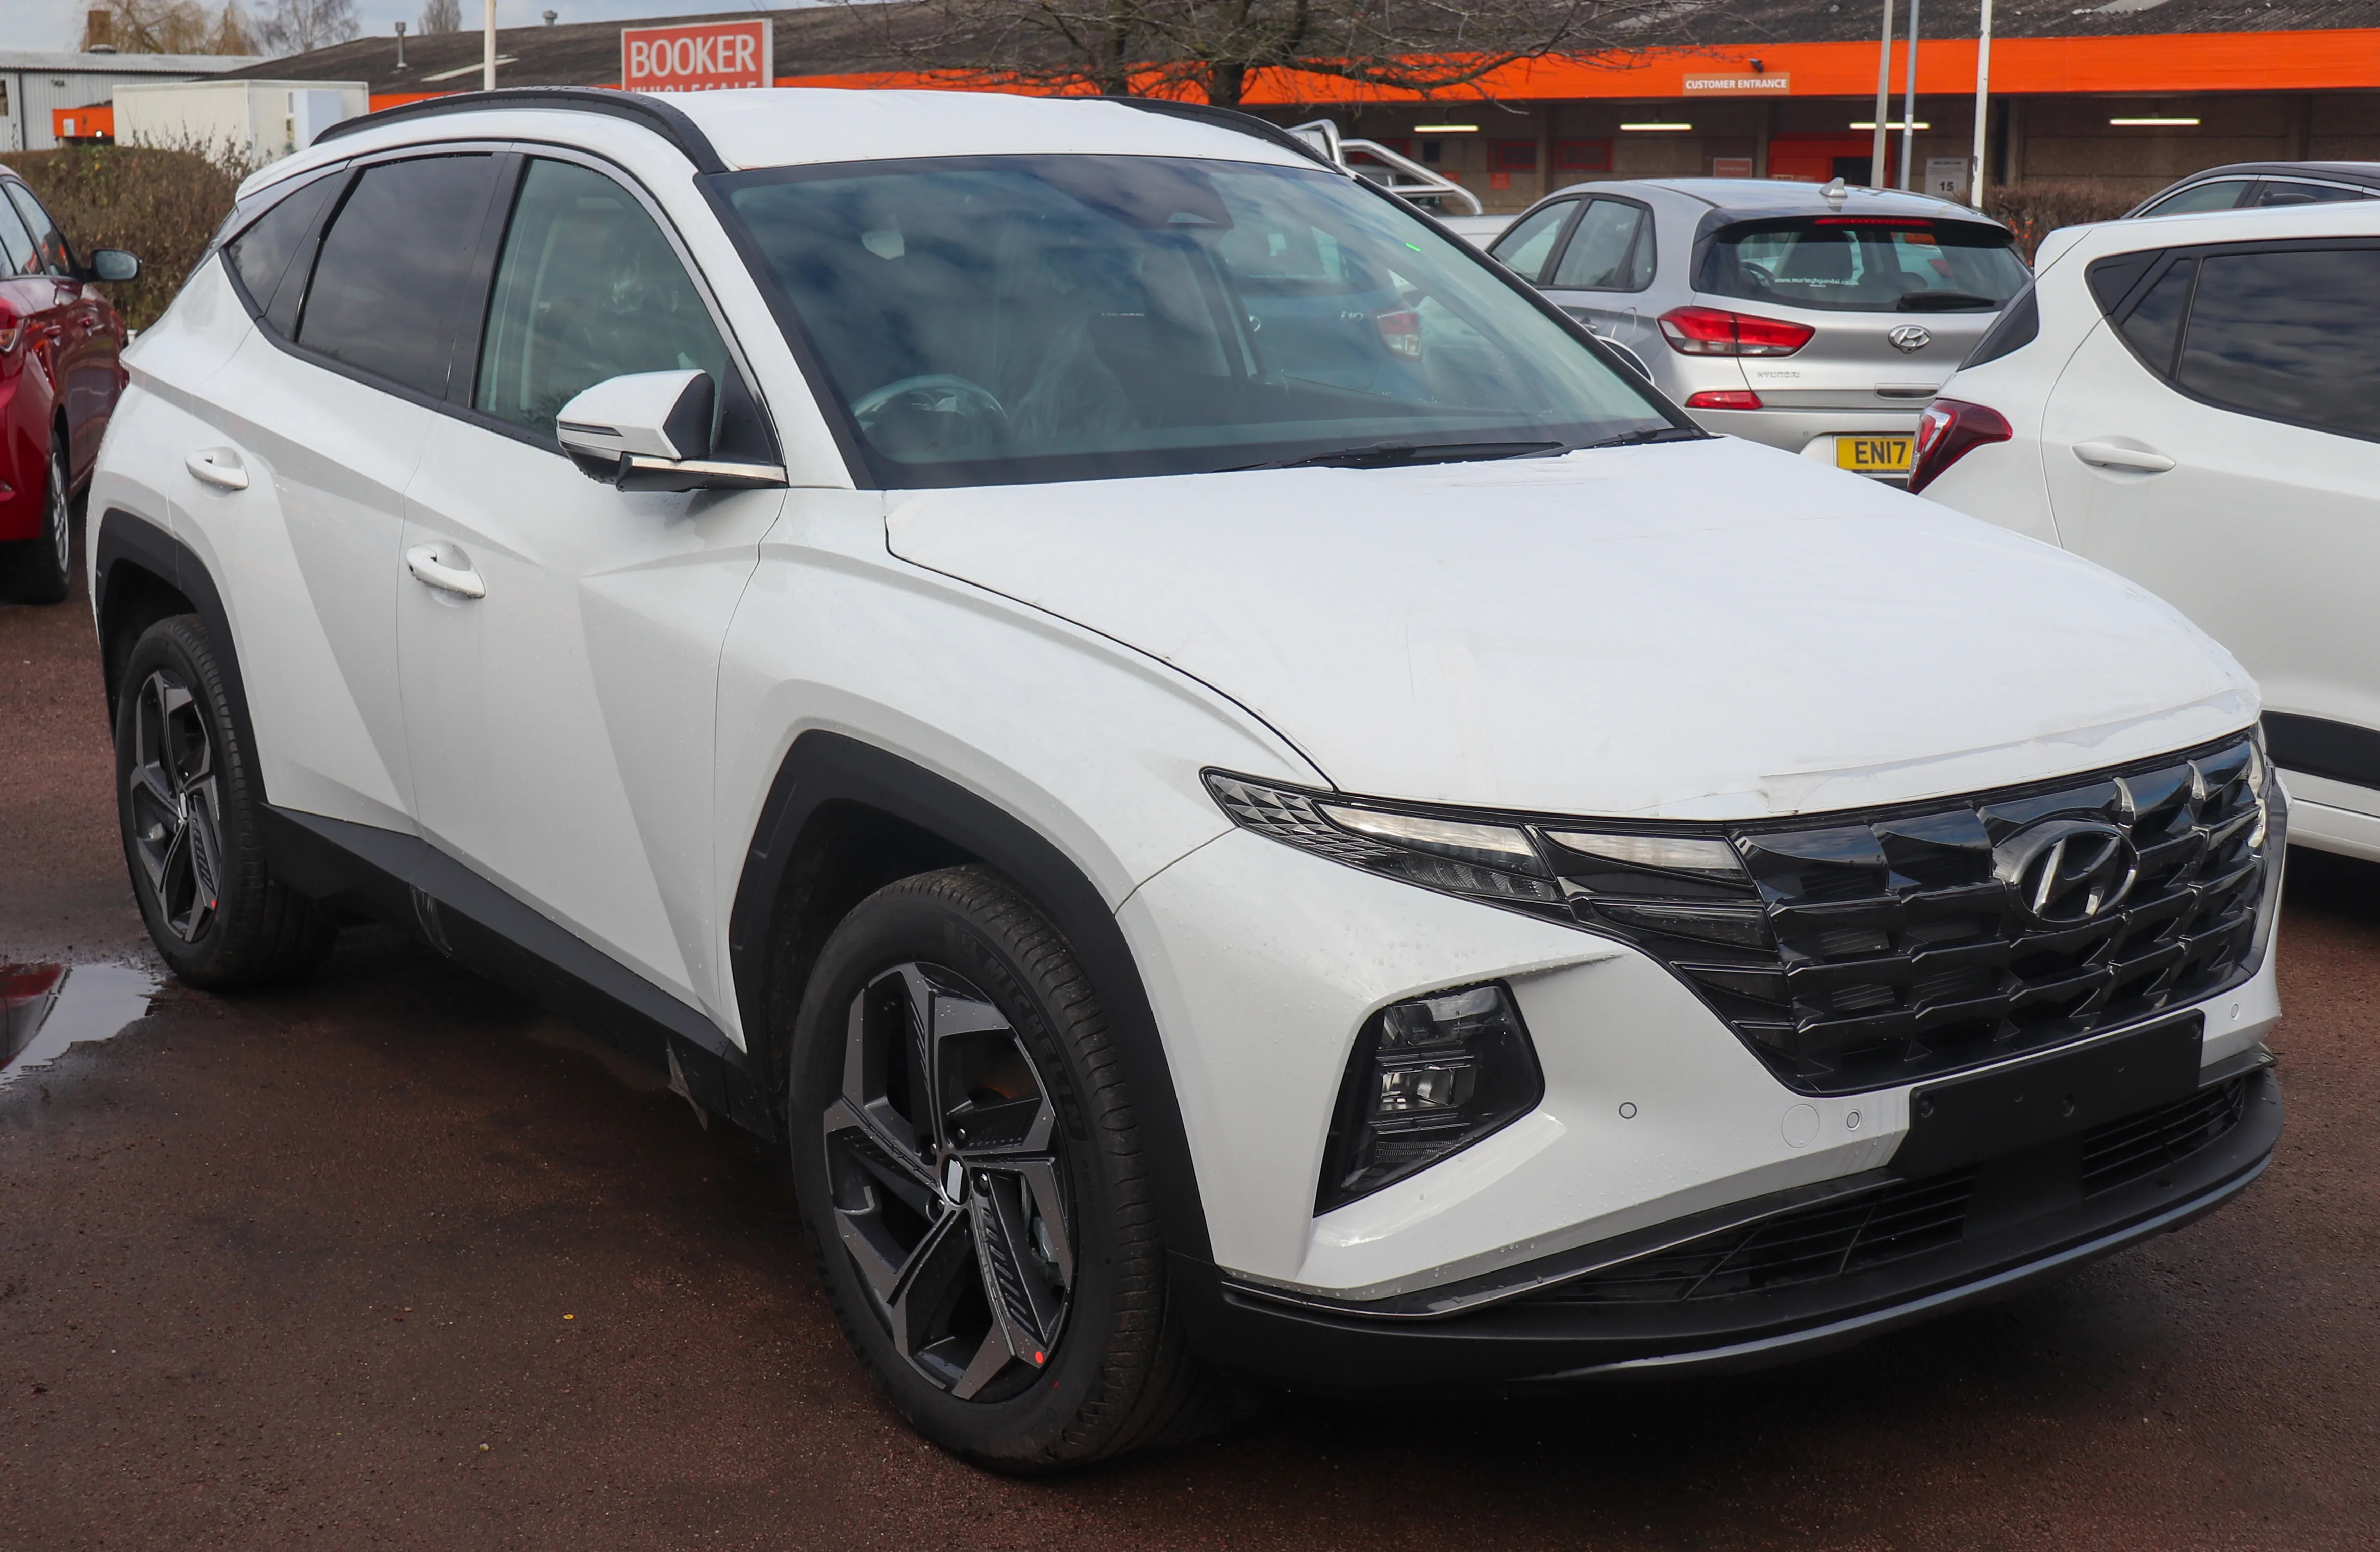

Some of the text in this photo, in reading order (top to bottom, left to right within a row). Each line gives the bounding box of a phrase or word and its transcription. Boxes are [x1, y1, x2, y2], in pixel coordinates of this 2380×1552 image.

[630, 34, 756, 78] BOOKER
[1686, 79, 1787, 89] CUSTOMER ENTRANCE
[1939, 181, 1953, 191] 15
[1855, 441, 1906, 464] EN17
[985, 956, 1084, 1129] MICHELIN
